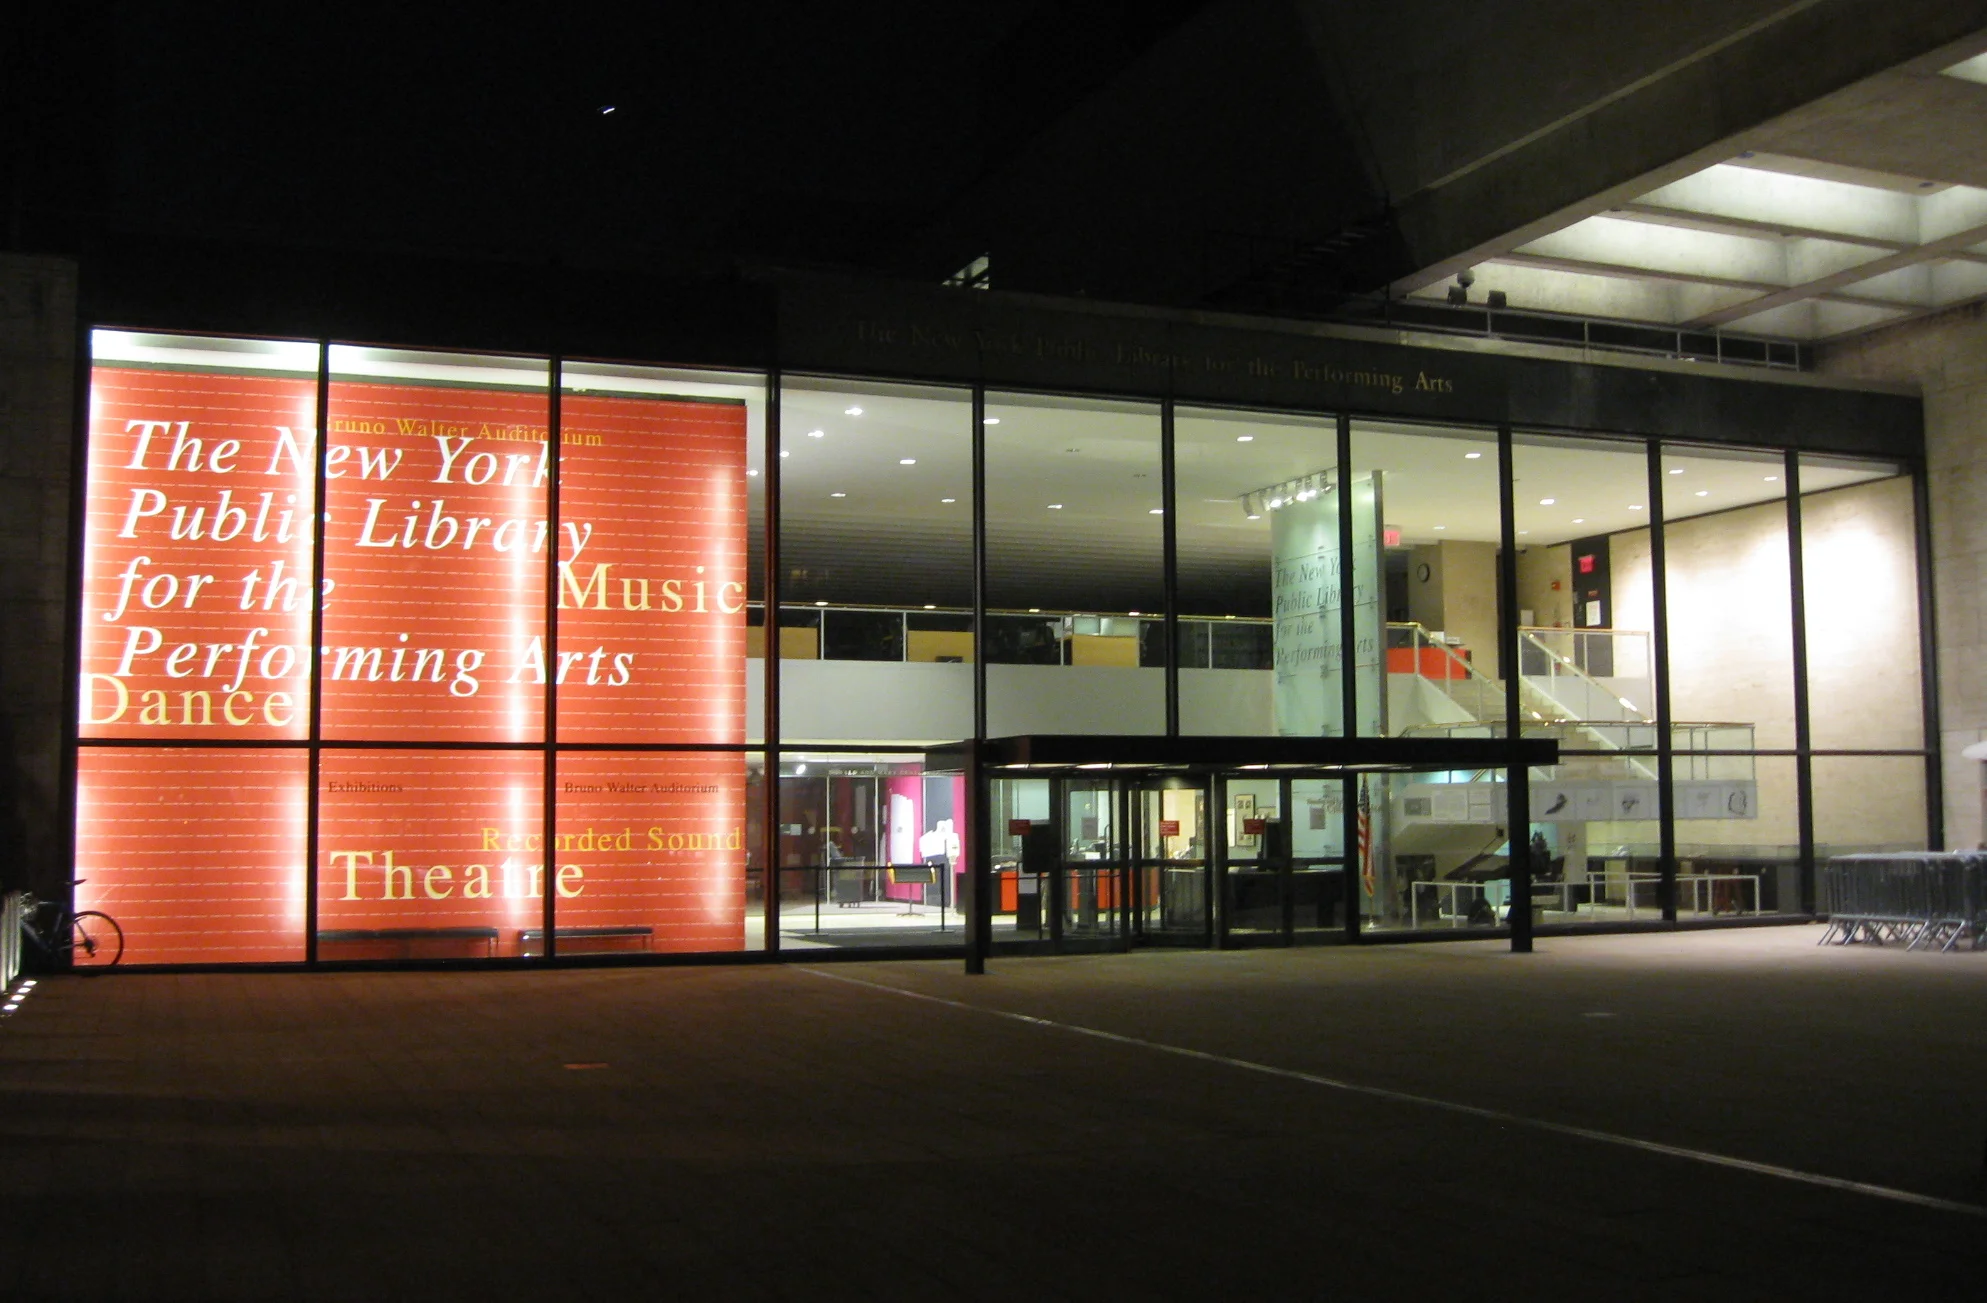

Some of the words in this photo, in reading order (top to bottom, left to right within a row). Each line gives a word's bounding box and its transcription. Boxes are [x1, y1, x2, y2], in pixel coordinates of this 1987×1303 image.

[1292, 359, 1403, 394] Performing
[1415, 371, 1453, 393] Arts
[123, 418, 240, 475] The
[265, 425, 403, 482] New
[327, 416, 386, 435] runo
[396, 418, 468, 439] Walter
[478, 423, 603, 447] Auditoium
[356, 497, 593, 560] Library
[103, 556, 213, 622] for
[243, 560, 336, 612] the
[557, 561, 744, 614] Music
[116, 625, 486, 697] Performing
[506, 635, 635, 687] Arts
[1356, 637, 1373, 653] rts
[79, 673, 294, 727] Dance
[328, 780, 403, 794] Exhibitions
[564, 781, 602, 794] Bruno
[607, 781, 647, 794] Walter
[650, 781, 719, 795] Auditorium
[648, 826, 742, 852] Sound
[329, 848, 586, 901] Theatre
